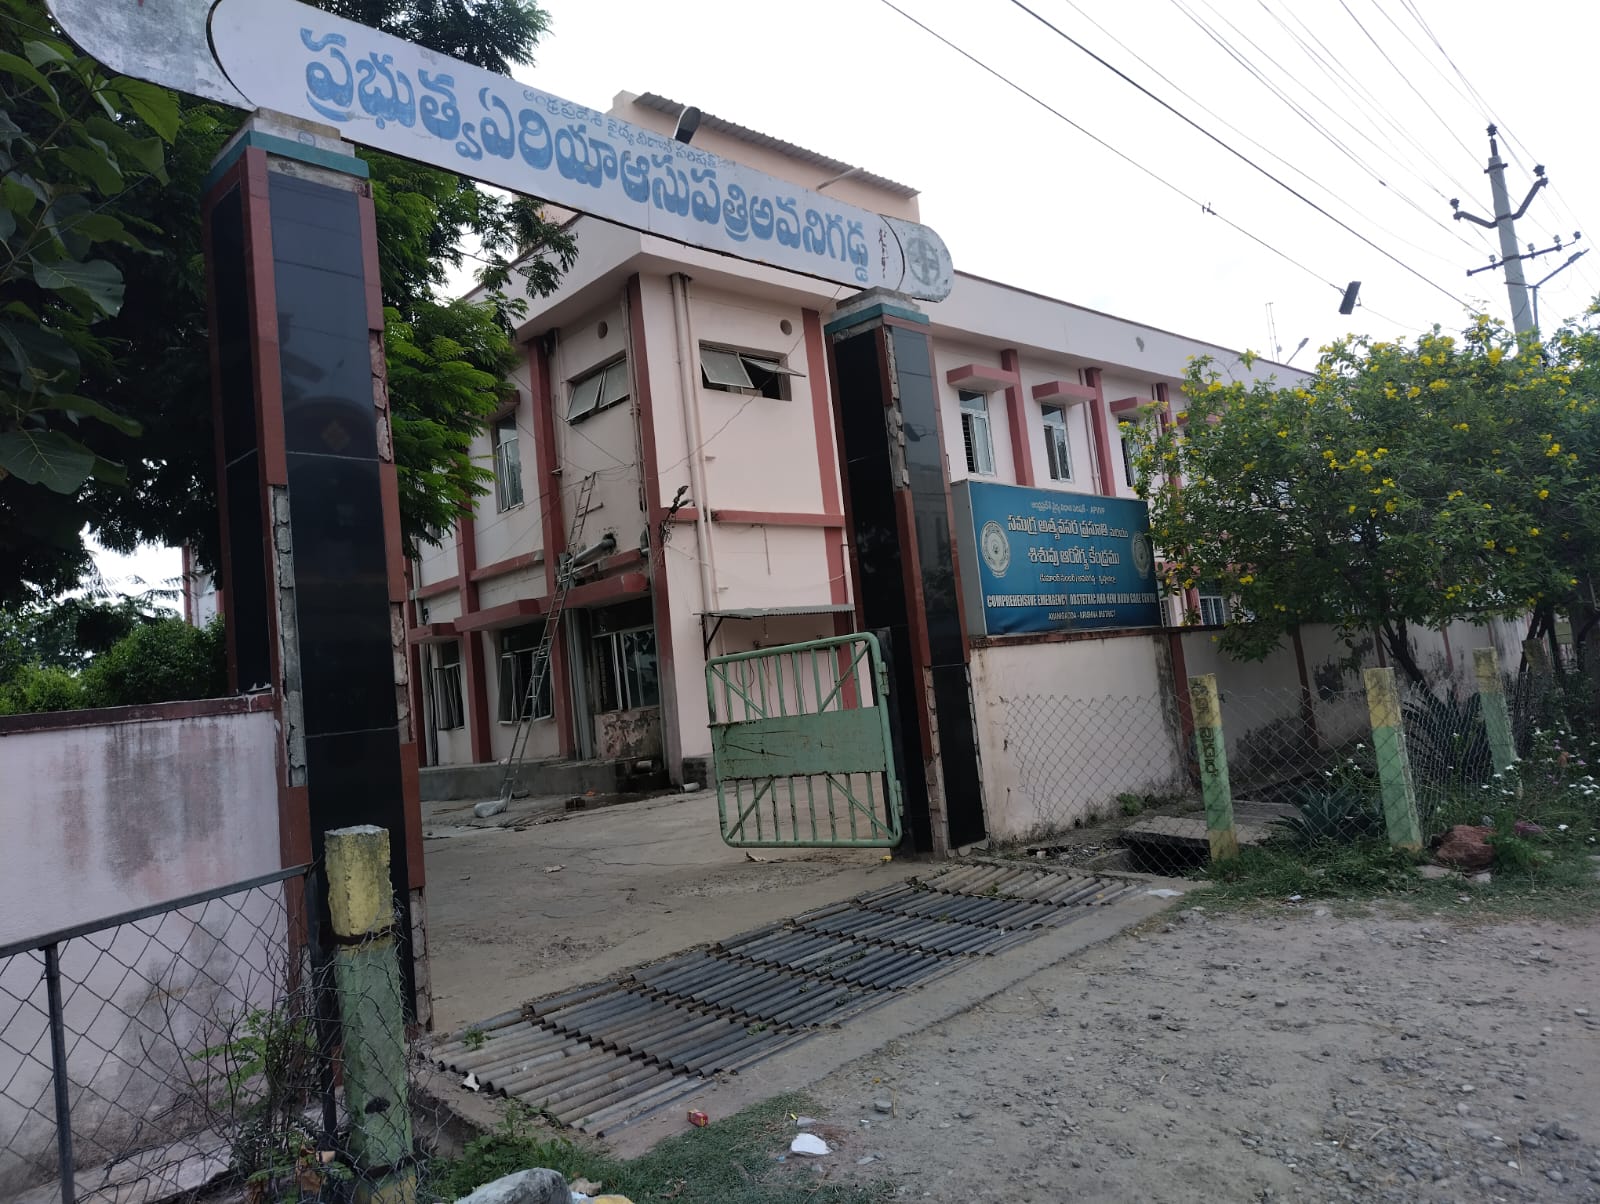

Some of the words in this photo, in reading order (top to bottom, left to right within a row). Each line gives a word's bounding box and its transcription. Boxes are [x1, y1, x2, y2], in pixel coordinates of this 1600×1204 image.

[300, 27, 483, 161] ప్రభుత్వ
[478, 87, 618, 189] ఏరియా
[620, 149, 750, 242] ఆసుపత్రి
[750, 195, 869, 283] అవనిగడ్డ
[1007, 514, 1038, 535] సమగ్ర
[1038, 517, 1078, 540] అత్యవసర
[1079, 519, 1109, 538] ప్రసూతి
[1060, 546, 1089, 570] ఆరోగ్య
[1088, 546, 1120, 567] కేంద్రము
[987, 594, 1037, 607] COMPREHENSIVE
[1037, 594, 1067, 606] EMERGENCY
